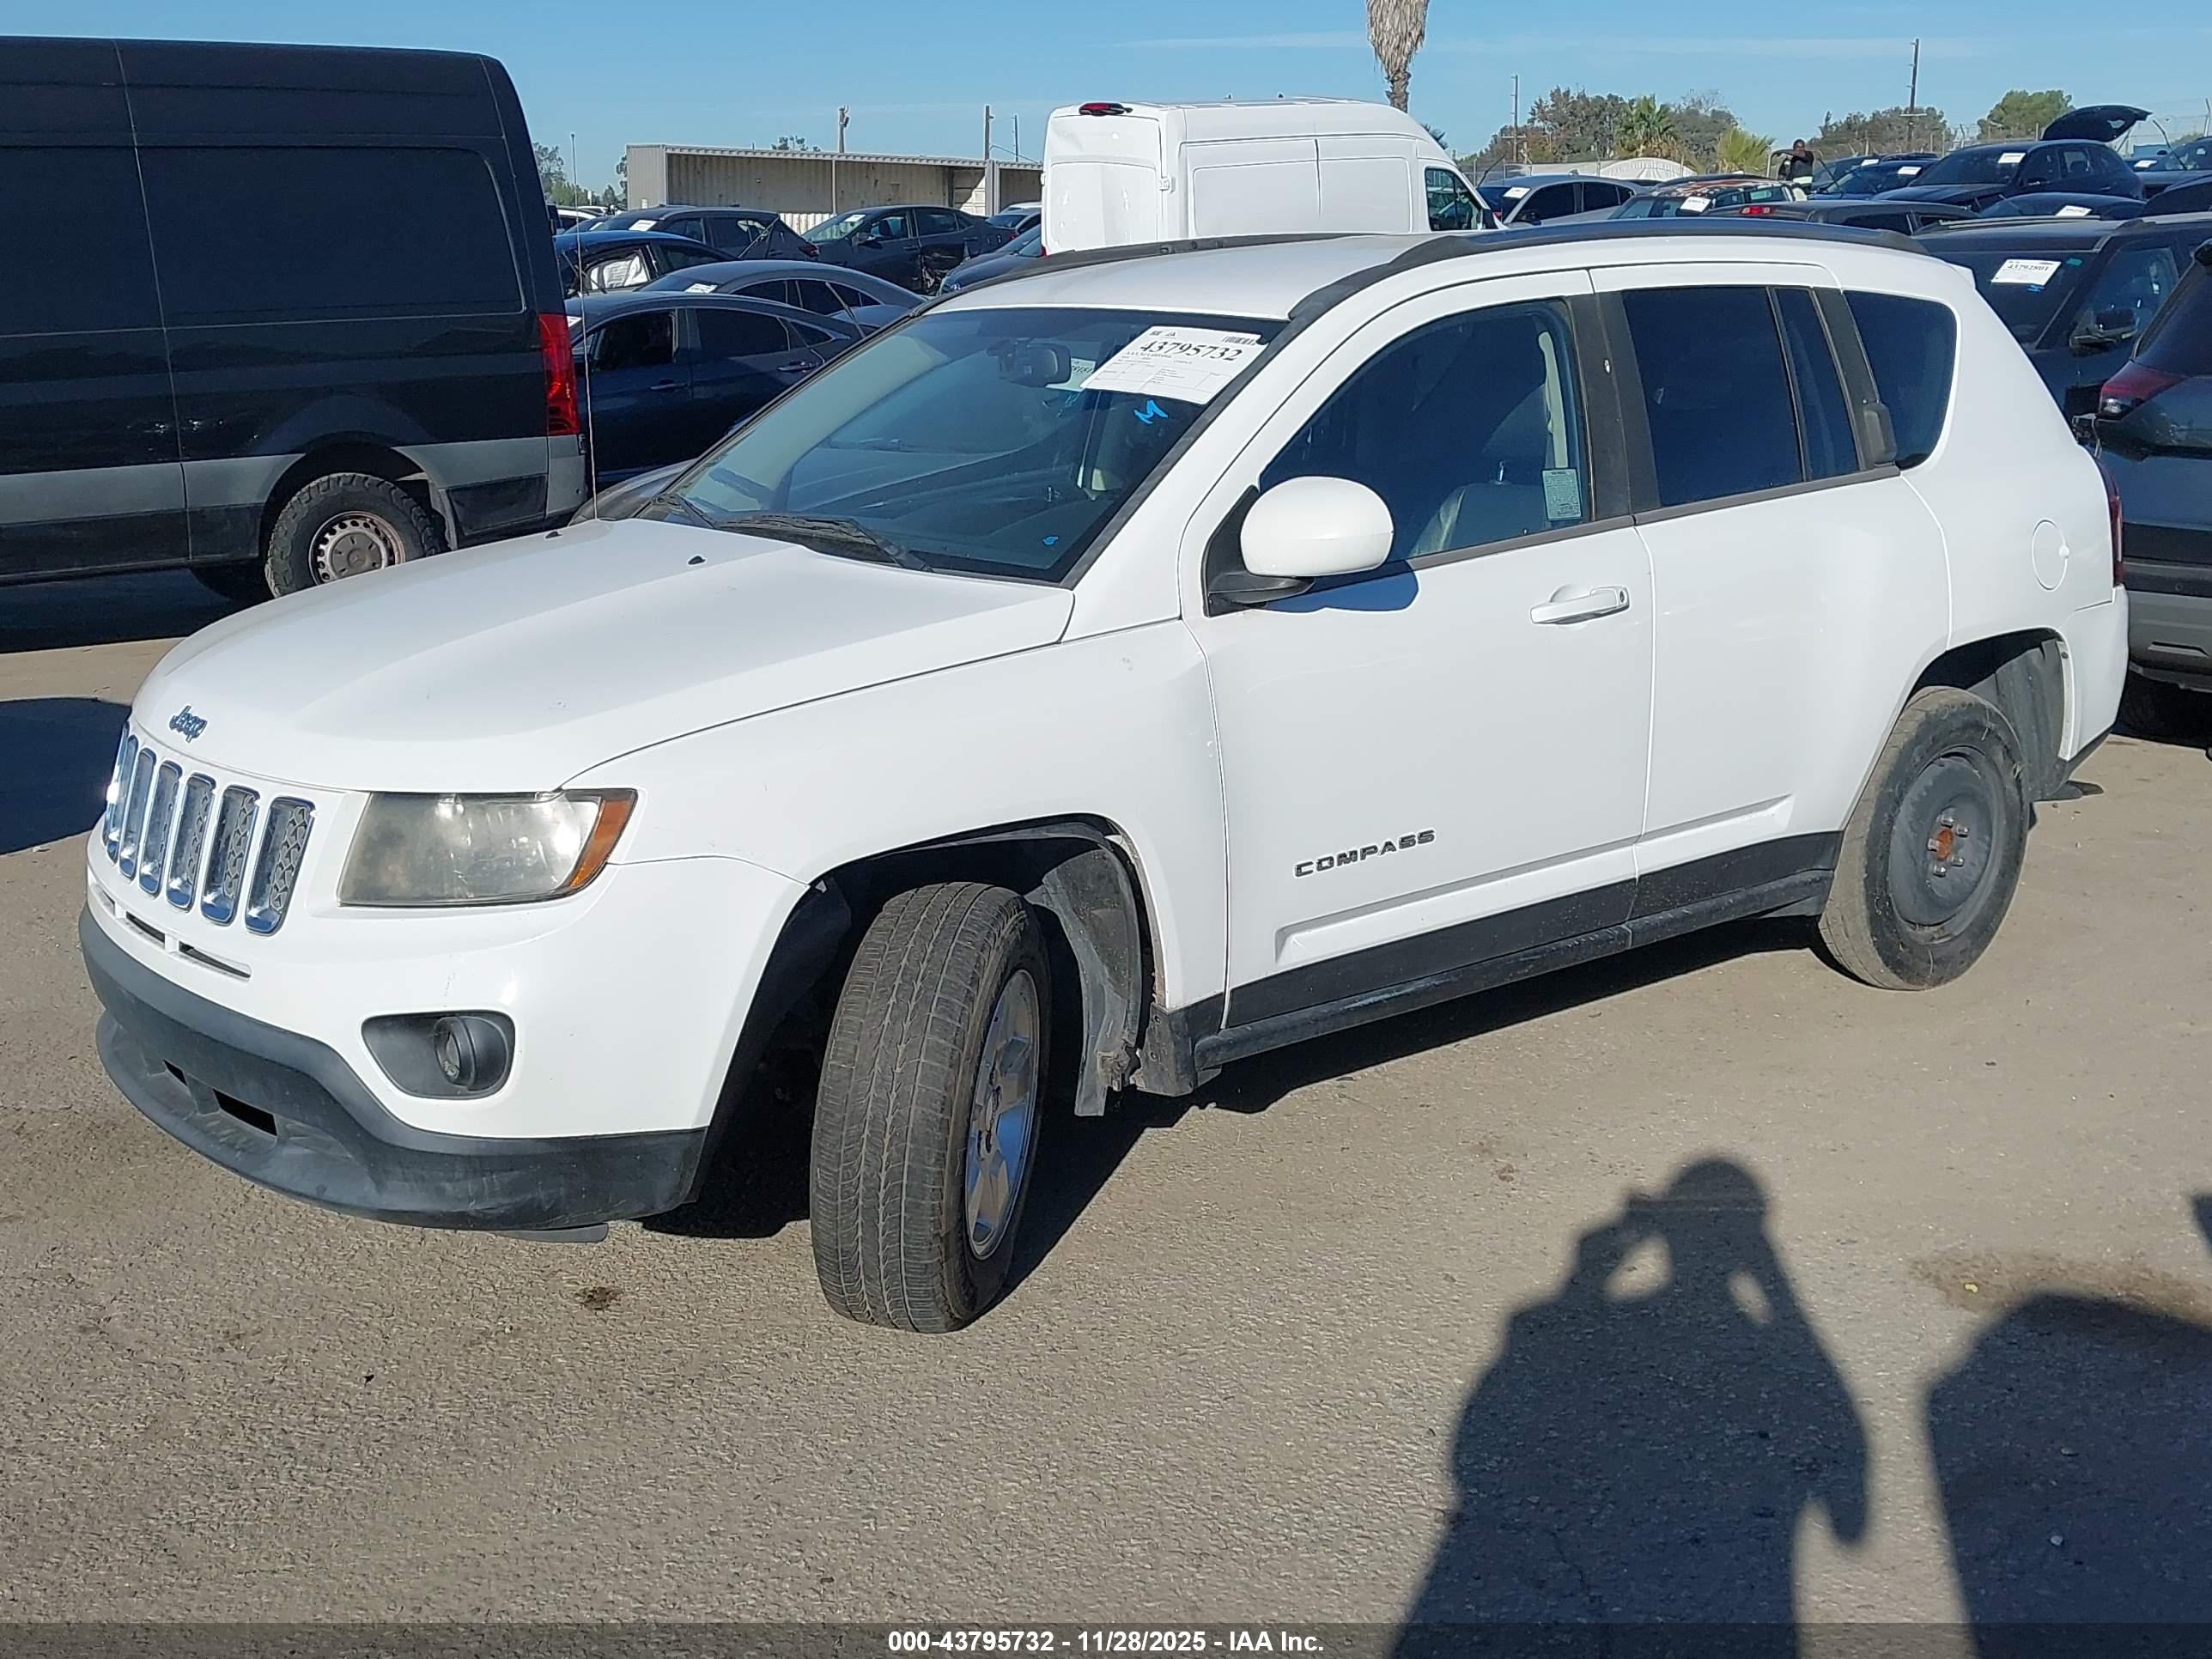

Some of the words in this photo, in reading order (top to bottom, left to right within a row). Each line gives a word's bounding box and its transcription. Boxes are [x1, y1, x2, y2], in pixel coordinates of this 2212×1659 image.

[1139, 340, 1243, 362] 43795732
[169, 705, 208, 744] Jeep
[1294, 830, 1436, 877] COMPASS
